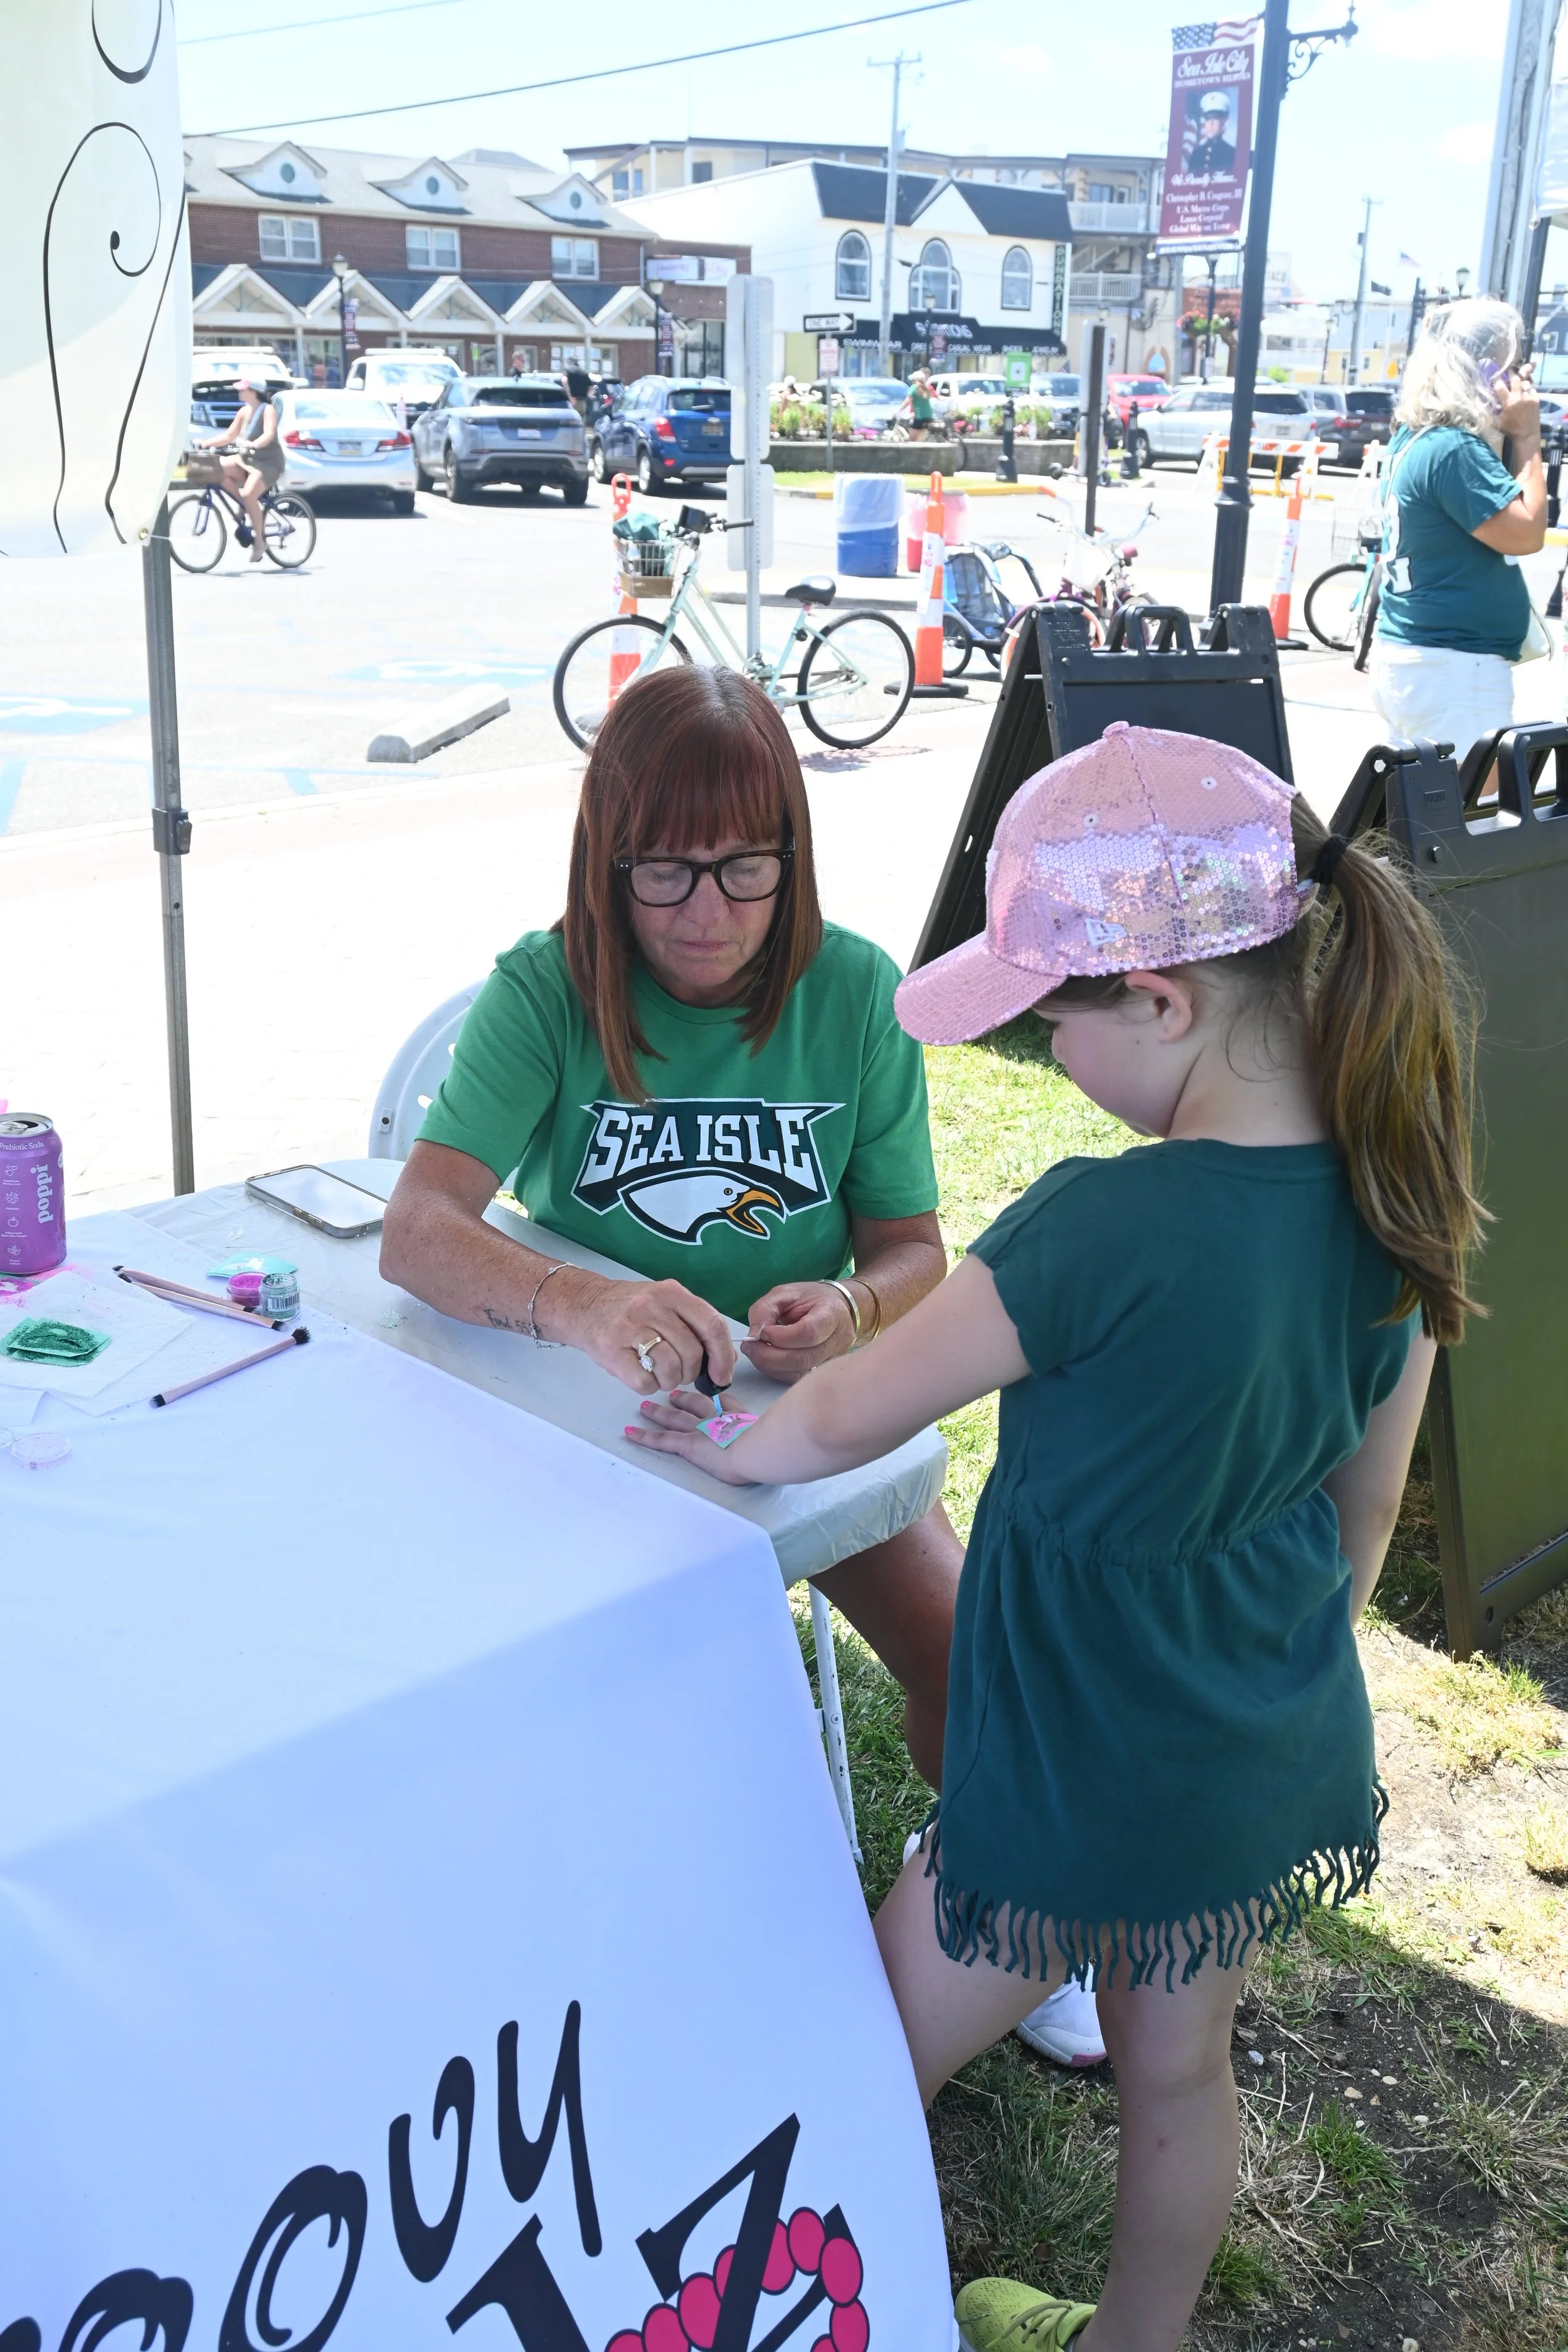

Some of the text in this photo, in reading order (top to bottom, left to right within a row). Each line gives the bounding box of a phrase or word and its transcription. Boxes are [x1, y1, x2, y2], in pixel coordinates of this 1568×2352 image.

[1177, 55, 1201, 78] Sea
[1226, 50, 1249, 75] City
[843, 338, 903, 349] SWIMWAR
[947, 343, 972, 352] CASUAL
[972, 344, 992, 352] WEAR
[1032, 346, 1059, 354] JEWELRY
[0, 1141, 45, 1150] Prebiotic Soda
[579, 1108, 818, 1192] SEA ISLE
[30, 1164, 54, 1224] poppi
